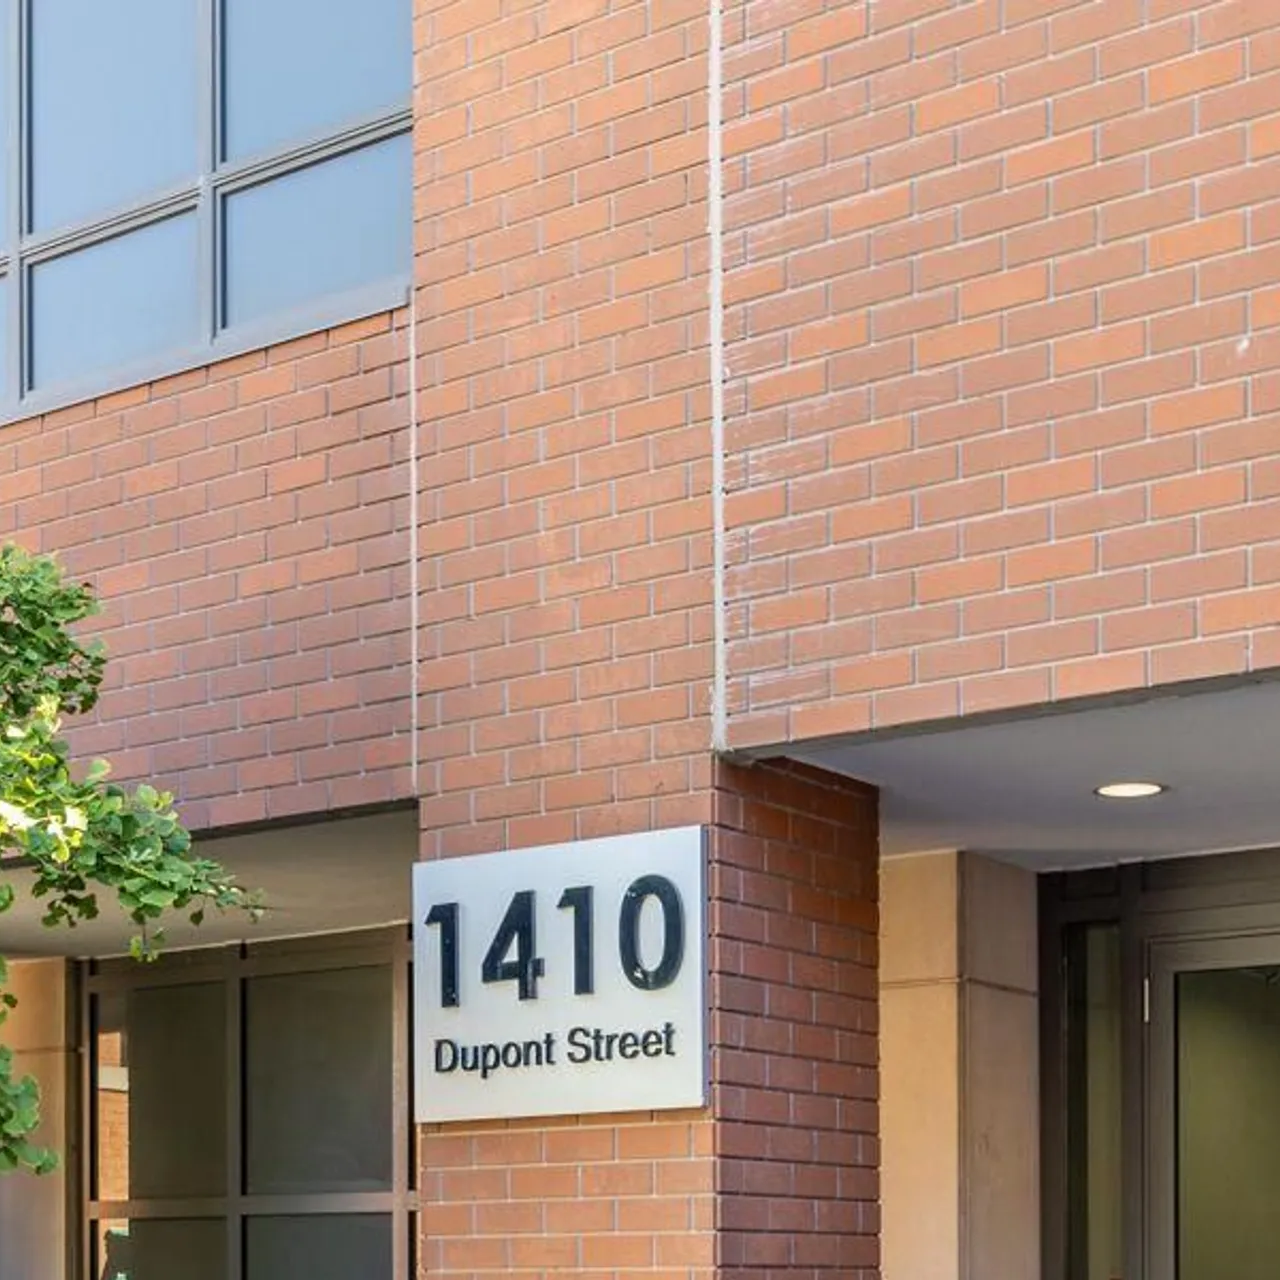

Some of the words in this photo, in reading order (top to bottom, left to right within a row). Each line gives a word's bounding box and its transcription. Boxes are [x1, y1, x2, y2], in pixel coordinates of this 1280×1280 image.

[424, 874, 686, 1008] 1410
[434, 1032, 556, 1078] Dupont
[567, 1021, 676, 1063] Street
